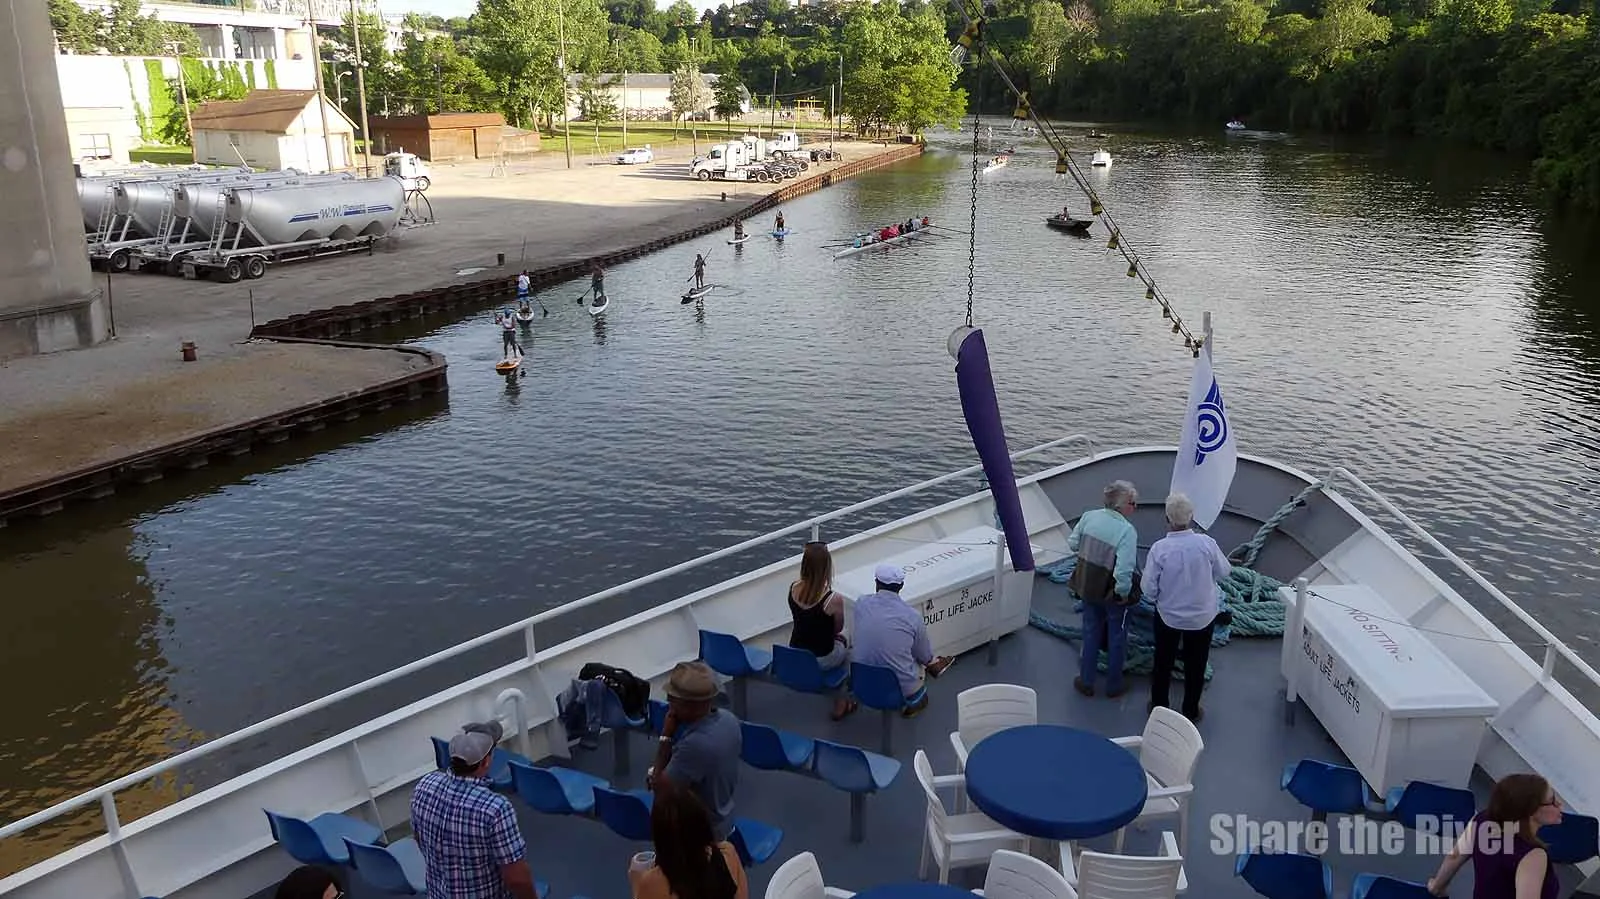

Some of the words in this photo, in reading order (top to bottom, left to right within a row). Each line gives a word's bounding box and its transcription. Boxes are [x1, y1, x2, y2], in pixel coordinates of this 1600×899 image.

[915, 546, 970, 568] SITTING
[960, 588, 969, 601] 35
[923, 610, 945, 625] DULT
[948, 602, 965, 616] LIFE
[1303, 640, 1319, 665] ADULT
[1319, 660, 1333, 683] LIFE
[1333, 677, 1360, 713] JACKETS
